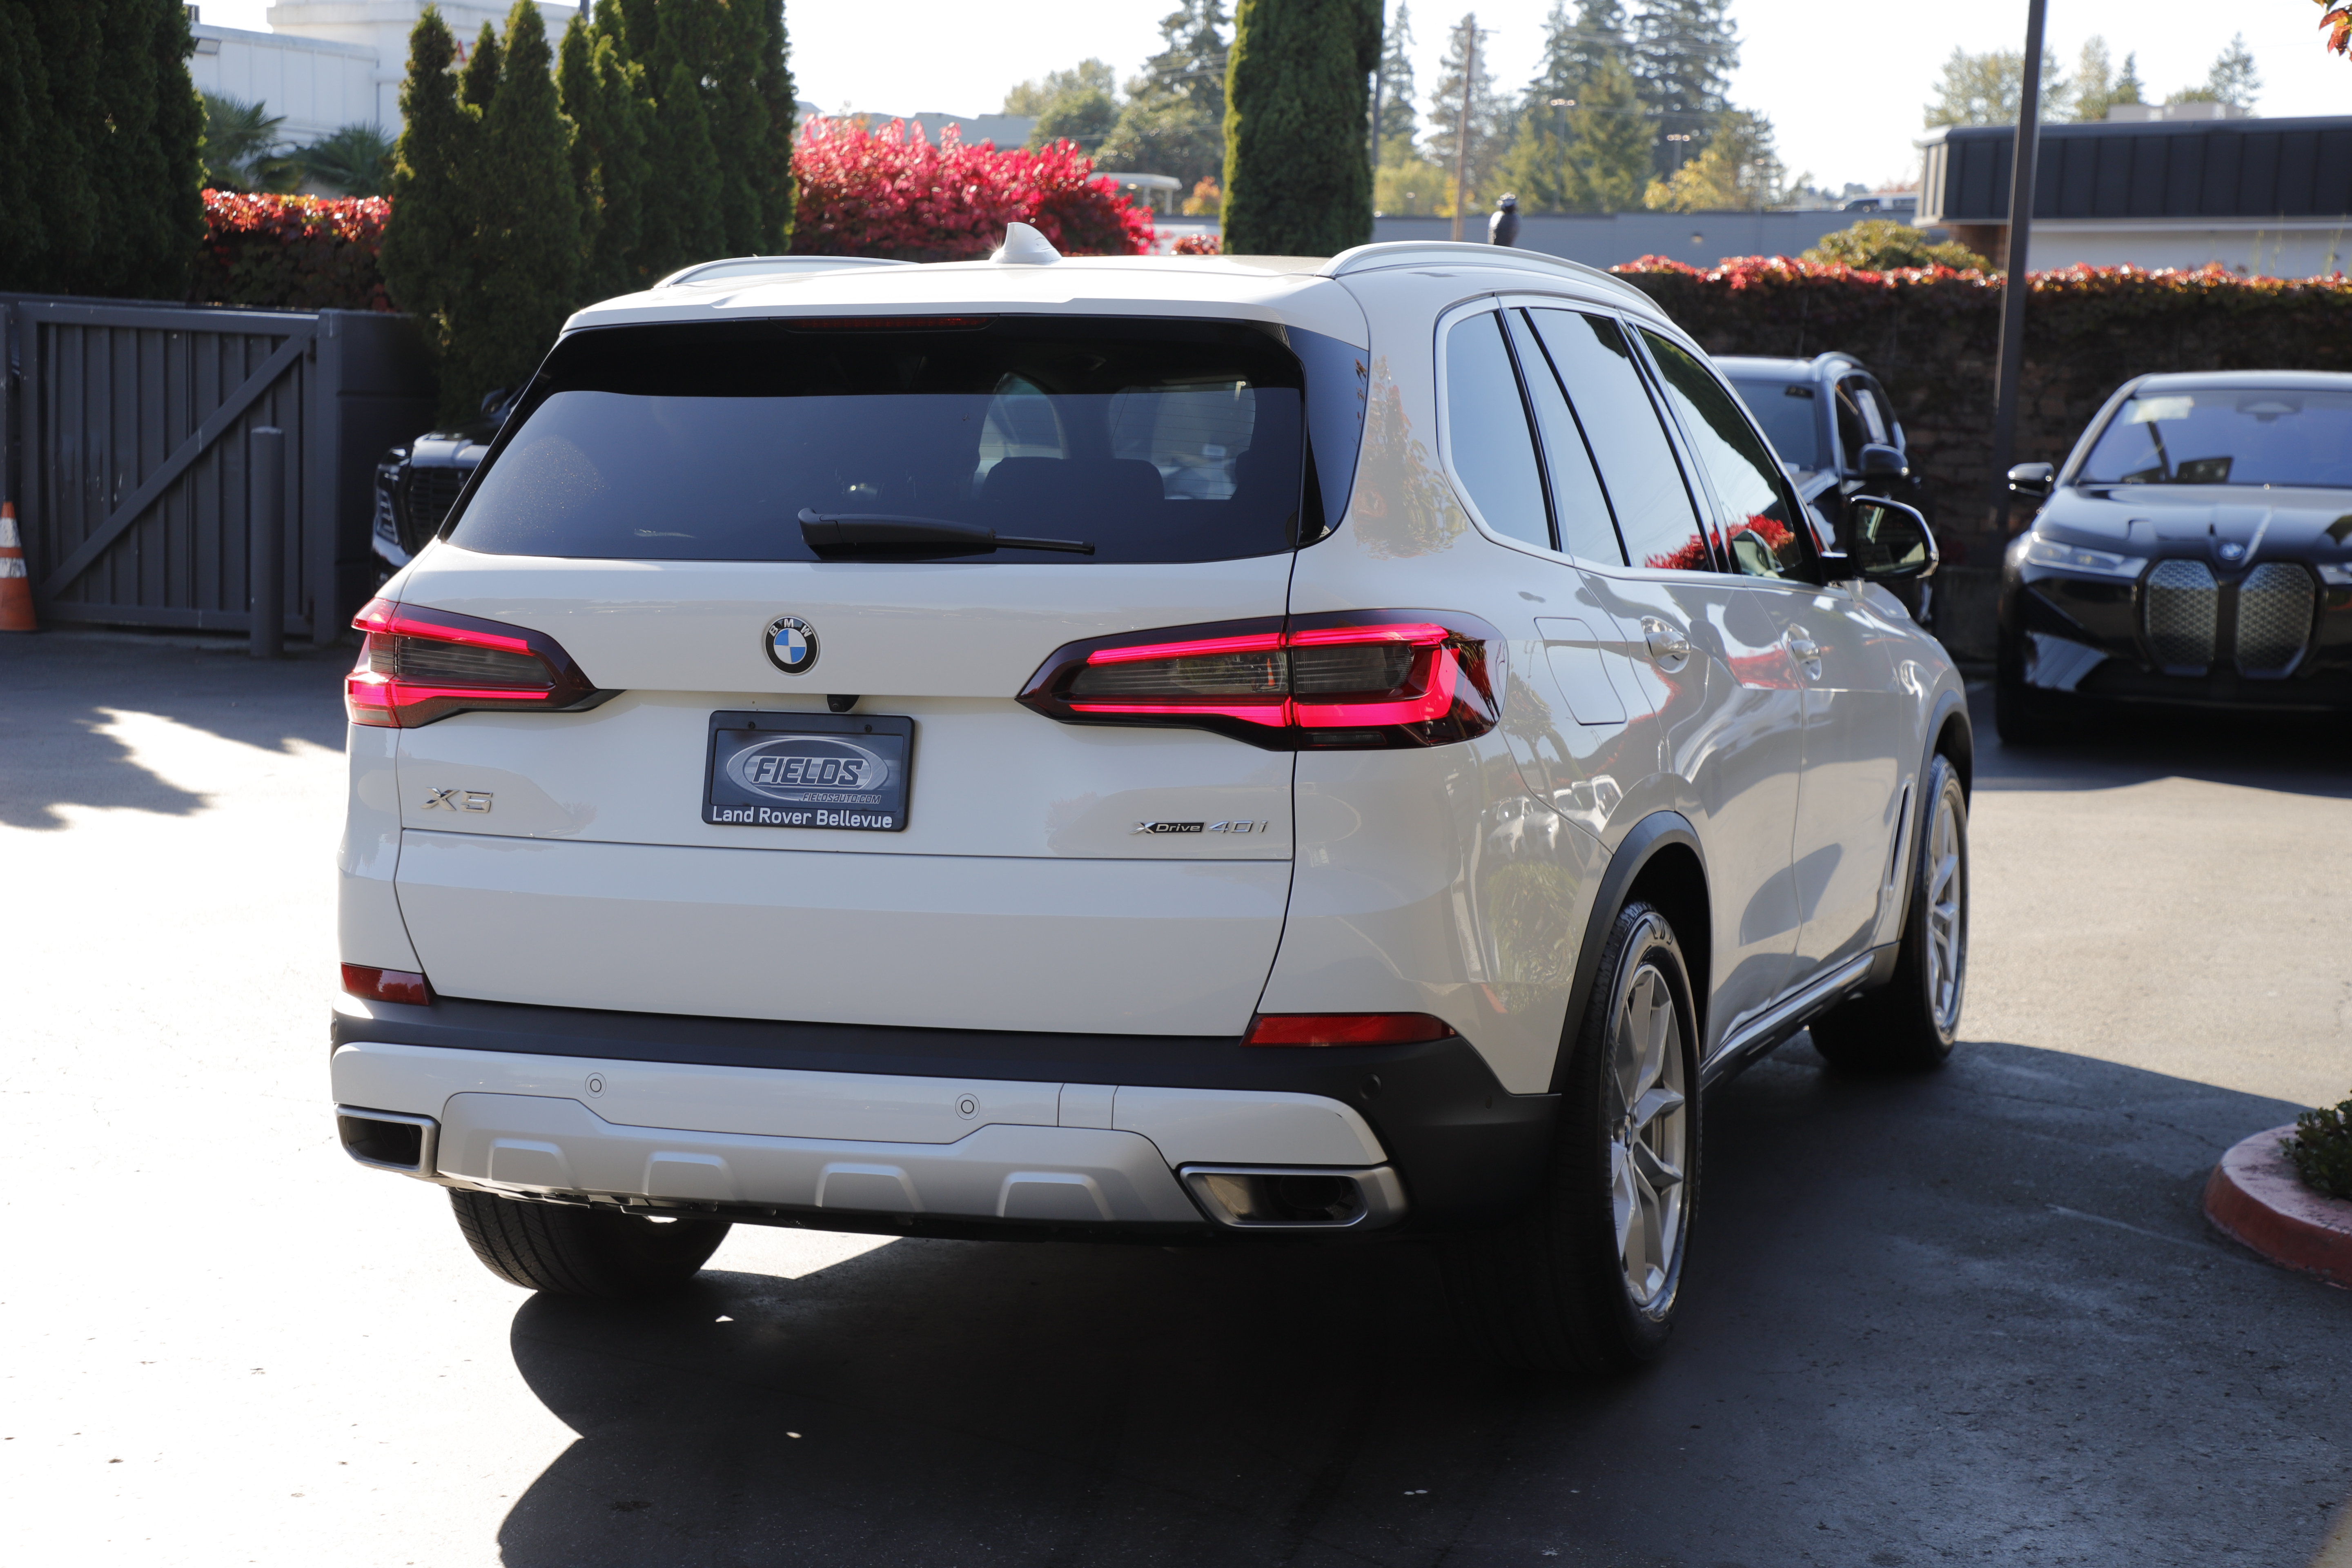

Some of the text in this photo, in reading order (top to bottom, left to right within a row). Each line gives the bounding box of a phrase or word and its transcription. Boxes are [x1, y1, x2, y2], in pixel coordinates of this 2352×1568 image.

[768, 618, 813, 637] BMW
[752, 756, 864, 786] FIELDS
[421, 787, 493, 813] X5
[713, 806, 893, 828] Land Rover Bellevue
